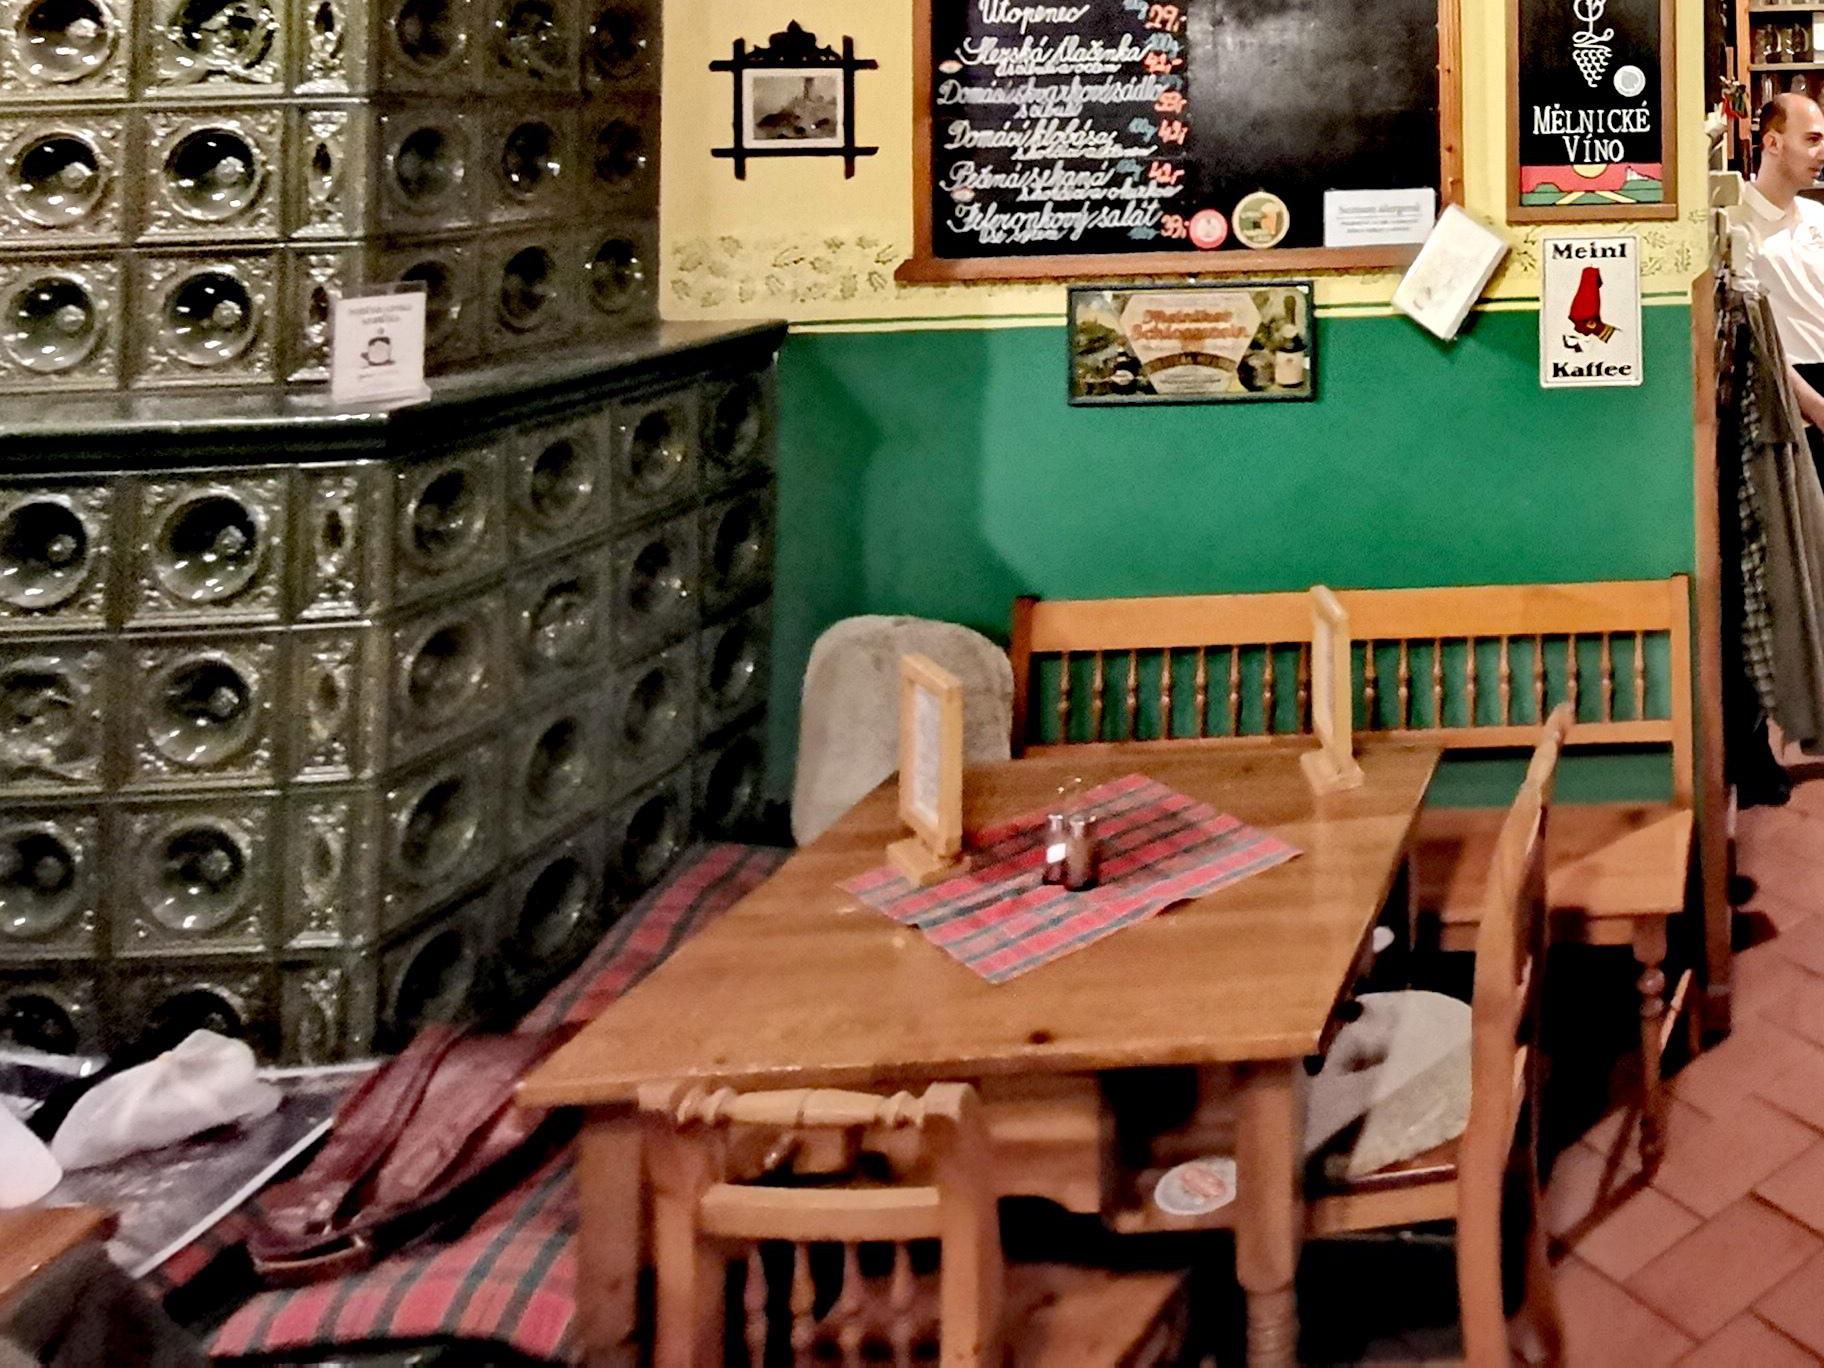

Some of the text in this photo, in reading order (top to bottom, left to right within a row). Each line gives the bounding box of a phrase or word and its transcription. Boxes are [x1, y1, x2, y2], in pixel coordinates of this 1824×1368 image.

[1533, 100, 1651, 135] MĚLNICKÉ
[1562, 133, 1625, 163] VÍNO
[1552, 241, 1627, 260] Meinl
[1552, 361, 1632, 378] Kaffee
